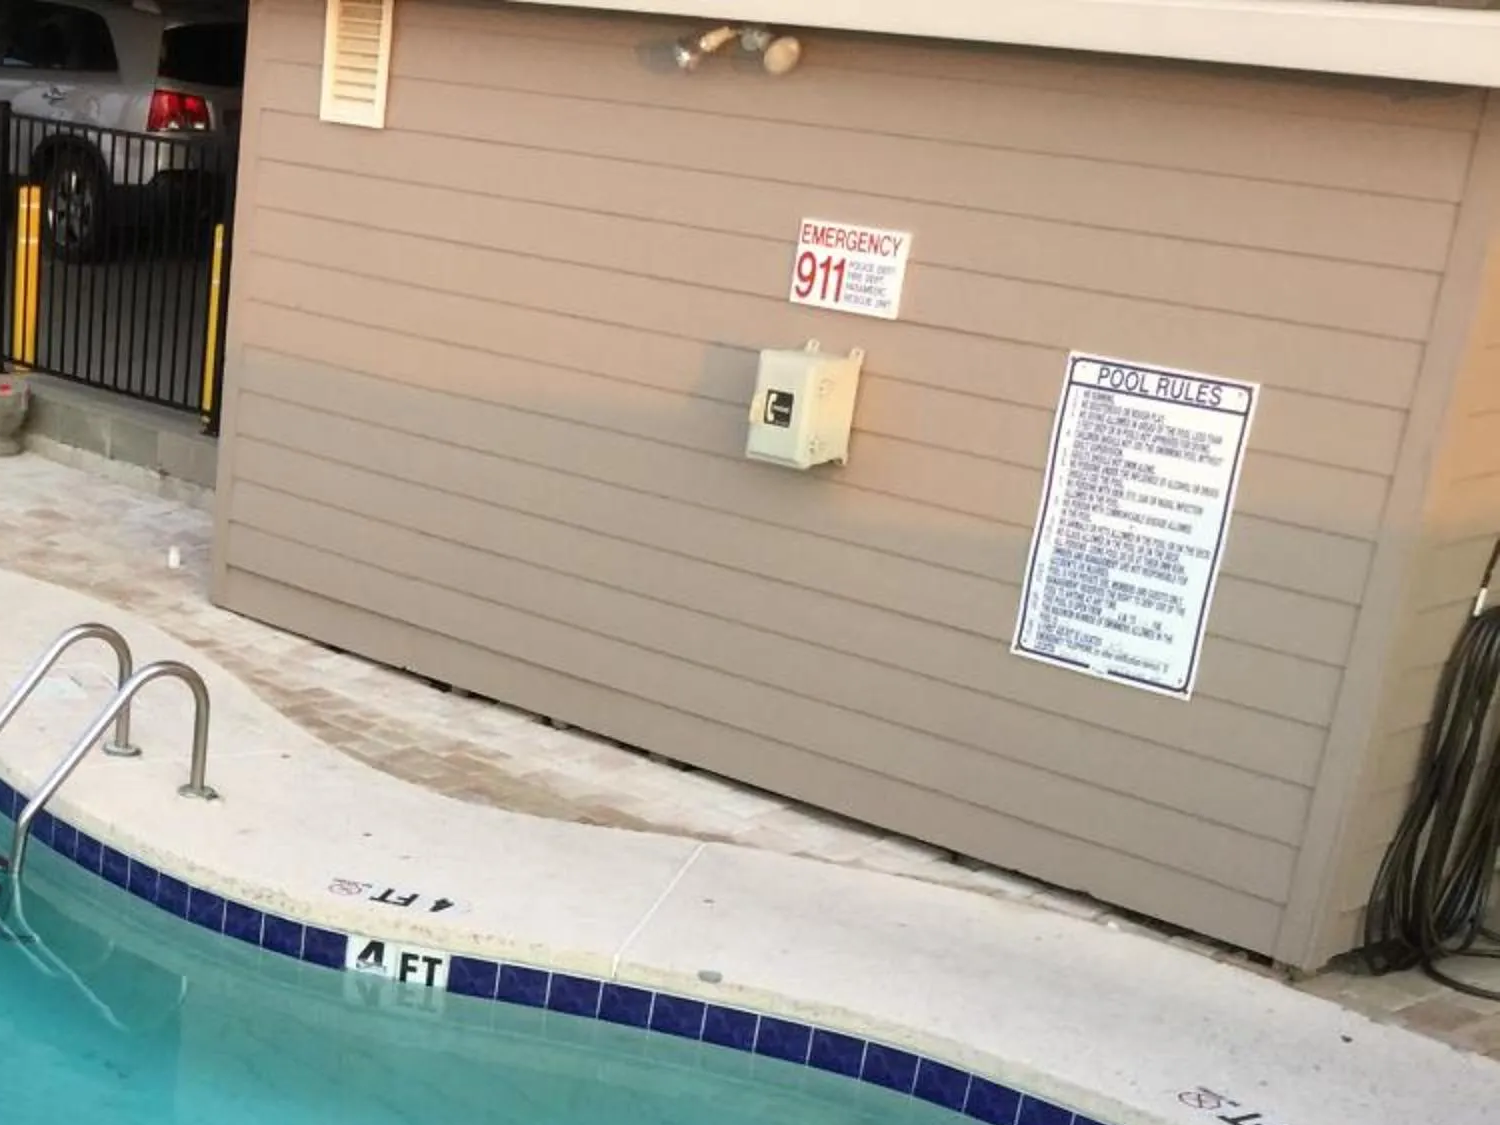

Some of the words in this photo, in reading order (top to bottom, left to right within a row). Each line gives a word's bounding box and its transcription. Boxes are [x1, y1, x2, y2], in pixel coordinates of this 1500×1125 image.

[802, 223, 903, 257] EMERGENCY
[795, 251, 846, 303] 911
[1097, 366, 1150, 395] POOL
[1155, 376, 1223, 408] RULES
[368, 888, 419, 907] FT
[429, 898, 455, 913] 4
[399, 951, 443, 987] FT
